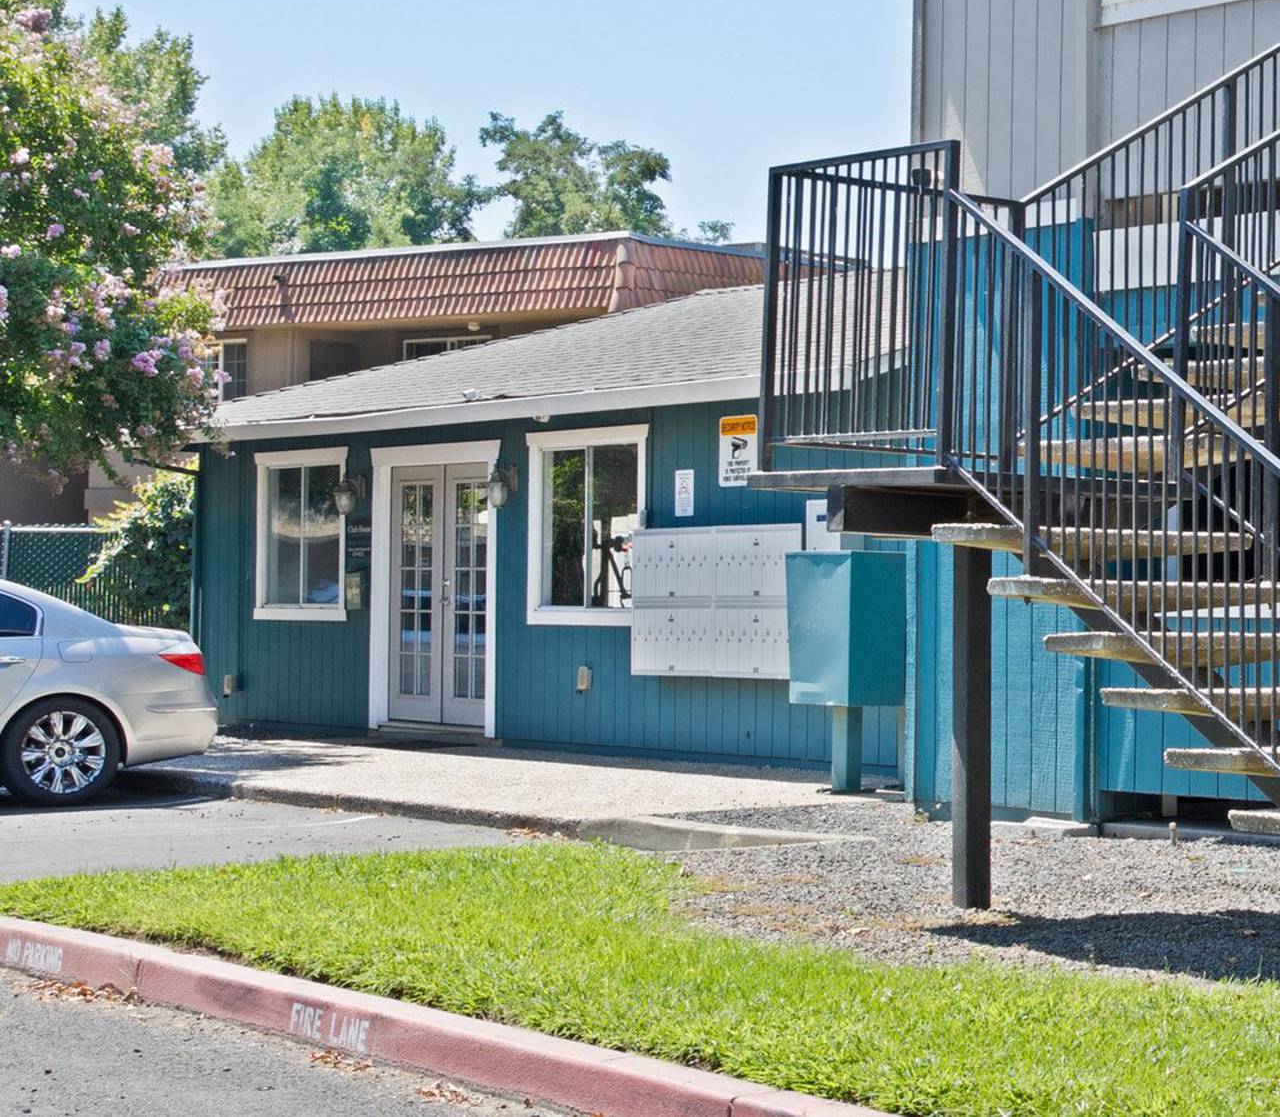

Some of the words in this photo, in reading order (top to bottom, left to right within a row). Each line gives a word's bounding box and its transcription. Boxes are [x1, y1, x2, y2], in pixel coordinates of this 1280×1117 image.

[7, 938, 21, 962] NO
[23, 942, 63, 974] PARKING
[289, 1002, 324, 1040] FIRE
[329, 1012, 370, 1052] LANE
